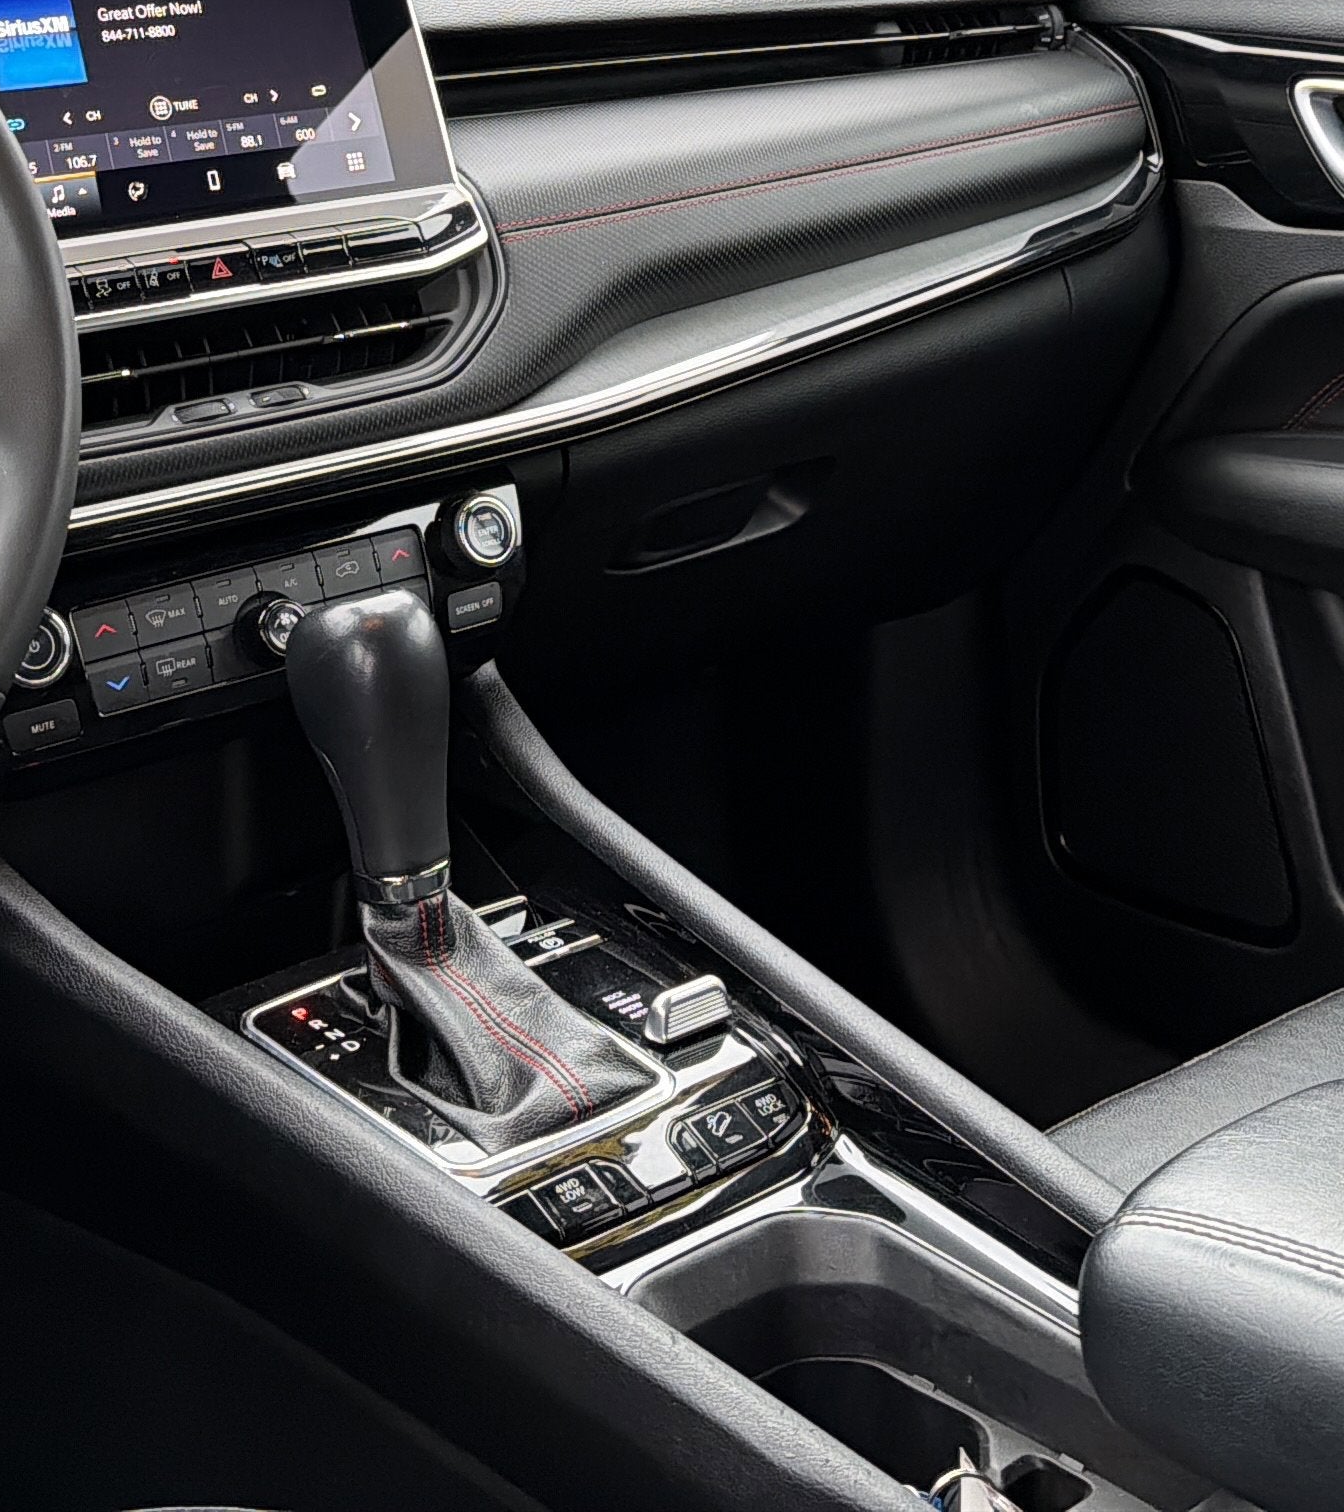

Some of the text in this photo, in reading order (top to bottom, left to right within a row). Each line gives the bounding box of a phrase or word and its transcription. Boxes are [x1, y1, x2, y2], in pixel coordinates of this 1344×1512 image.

[97, 0, 203, 22] Great Offer Now!
[101, 24, 176, 43] 844-711-8800
[172, 98, 199, 112] TUNE
[243, 92, 259, 104] CH
[85, 110, 102, 122] CH
[186, 129, 218, 141] Hold to
[295, 127, 316, 141] 600
[129, 135, 162, 148] Hold to
[194, 140, 215, 152] Save
[240, 134, 263, 149] 88.1
[136, 148, 159, 159] Save
[66, 154, 98, 170] 106.7
[46, 205, 77, 219] Media
[282, 252, 297, 263] OFF
[166, 270, 181, 282] OFF
[116, 280, 132, 291] OFF
[284, 577, 299, 590] A/C
[218, 593, 239, 607] AUTO
[455, 596, 495, 616] SCREEN OFF
[167, 606, 186, 619] MAX
[176, 657, 197, 670] REAR
[31, 720, 55, 734] MUTE
[291, 1007, 361, 1052] P R N D
[754, 1092, 777, 1109] 4WD
[758, 1098, 787, 1117] LOCK
[554, 1176, 580, 1195] 4WD
[559, 1186, 587, 1205] LOW
